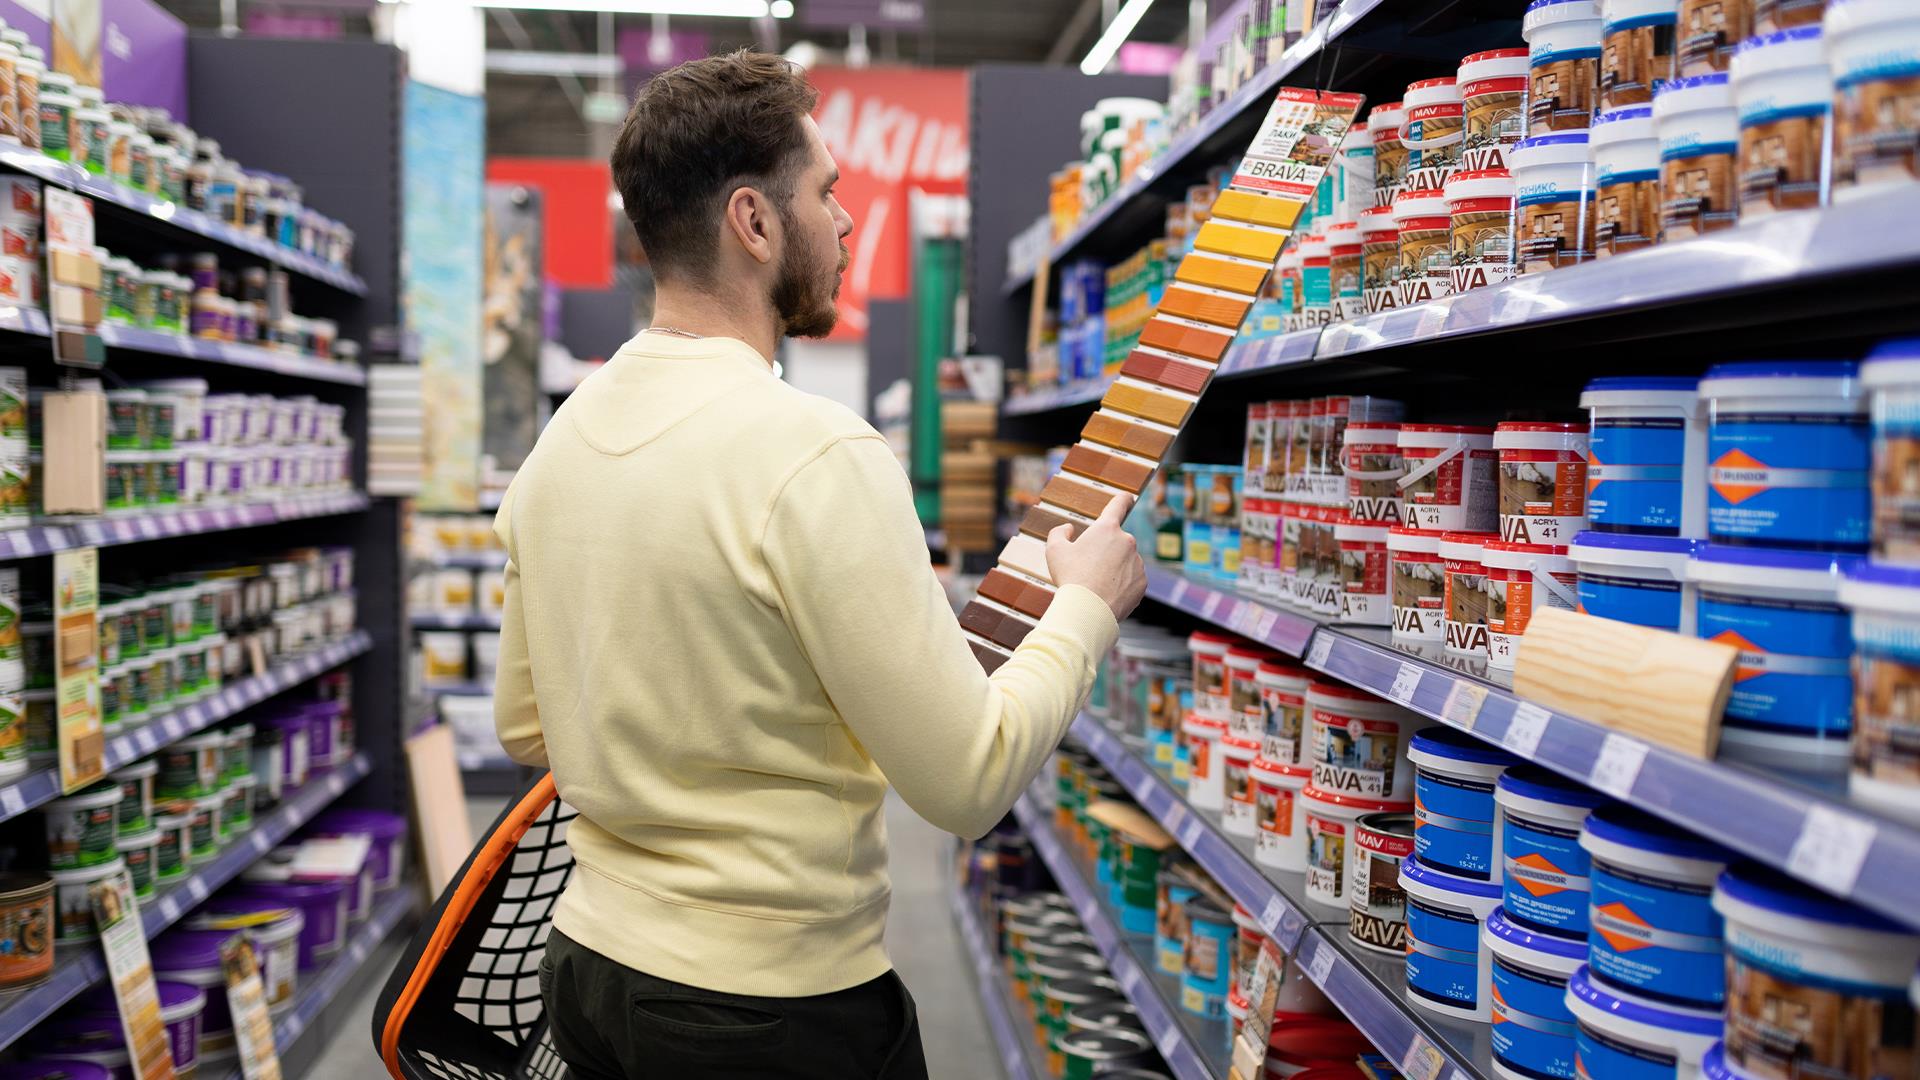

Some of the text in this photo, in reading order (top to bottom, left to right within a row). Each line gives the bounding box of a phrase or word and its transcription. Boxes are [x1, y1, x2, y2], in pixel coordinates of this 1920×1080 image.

[1415, 107, 1437, 117] MAV
[1463, 148, 1505, 171] AVA
[1251, 161, 1307, 182] BRAVA
[1520, 182, 1557, 196] ЕХНИКС
[1427, 515, 1440, 524] 41
[1533, 518, 1559, 526] ACRYL
[1542, 528, 1557, 538] 41
[1445, 623, 1489, 651] AVA
[1499, 645, 1509, 655] 41
[1314, 764, 1362, 792] RAVA
[1368, 783, 1381, 793] 41
[1358, 832, 1384, 849] MAV
[1459, 860, 1476, 869] 15-21
[1323, 881, 1333, 890] 41
